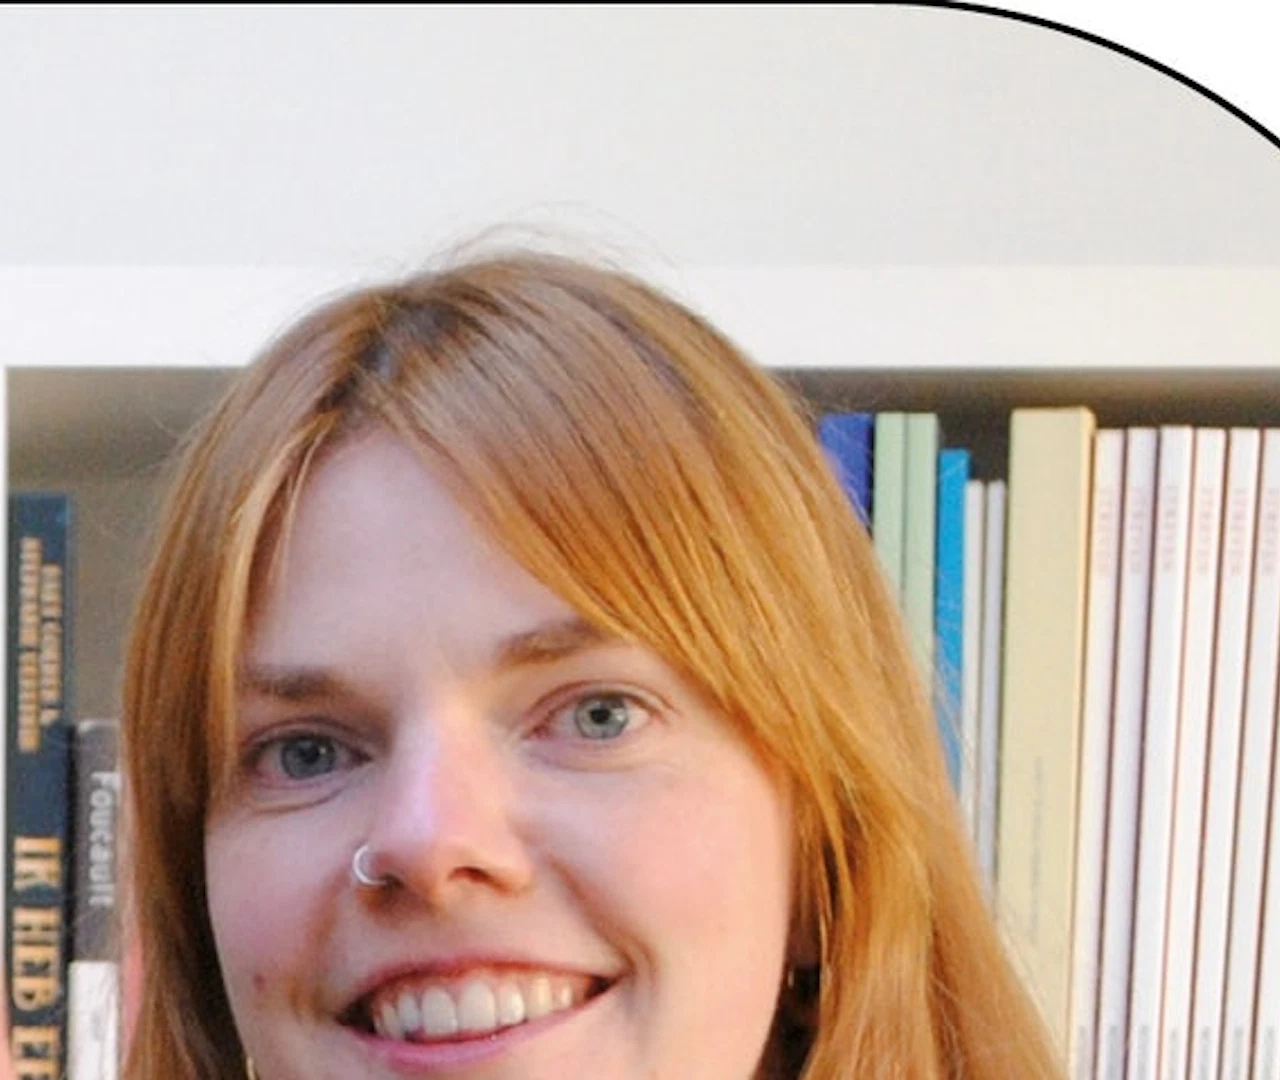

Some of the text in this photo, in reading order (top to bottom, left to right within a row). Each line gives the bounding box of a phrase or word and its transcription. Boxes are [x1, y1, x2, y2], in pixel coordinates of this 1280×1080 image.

[13, 834, 62, 892] IK
[88, 770, 121, 907] Foucault
[11, 906, 62, 1012] HEB
